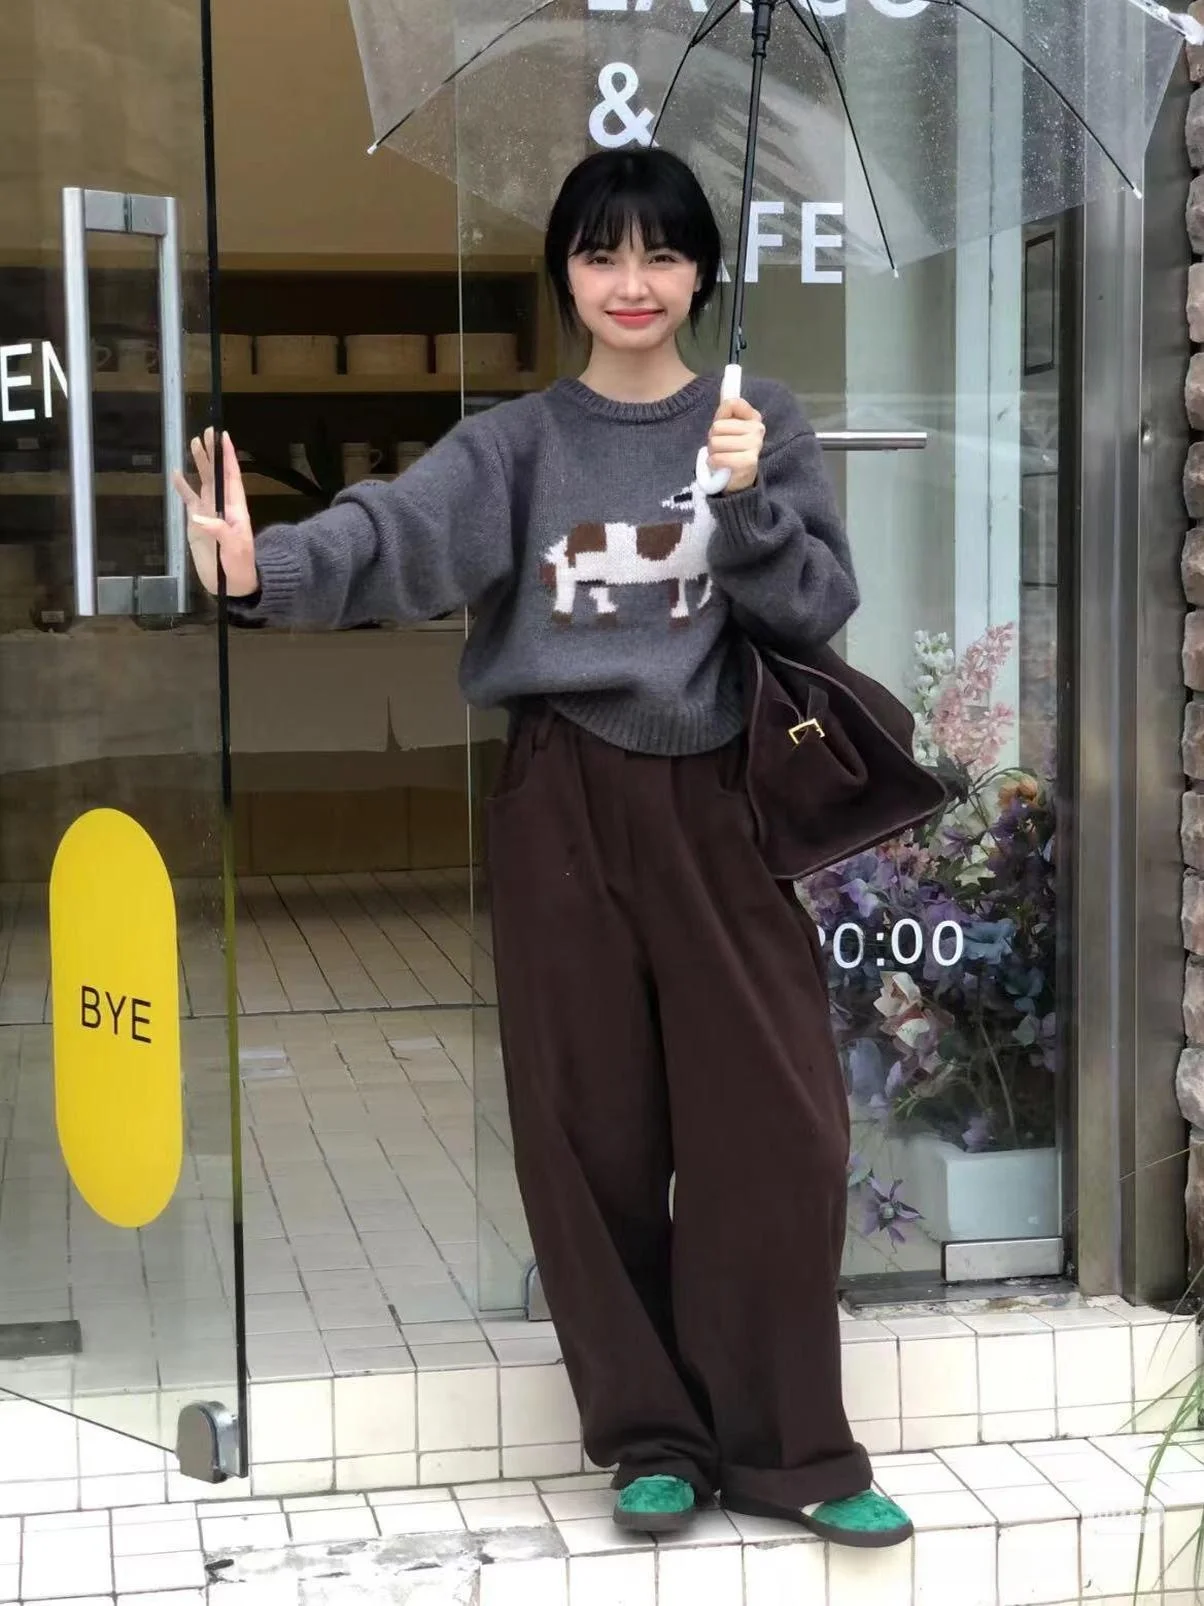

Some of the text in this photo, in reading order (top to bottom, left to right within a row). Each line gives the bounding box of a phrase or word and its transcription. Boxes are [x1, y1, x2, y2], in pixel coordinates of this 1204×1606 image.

[588, 62, 659, 148] &
[716, 201, 844, 283] FE
[817, 918, 964, 969] 0:00
[81, 985, 152, 1044] BYE
